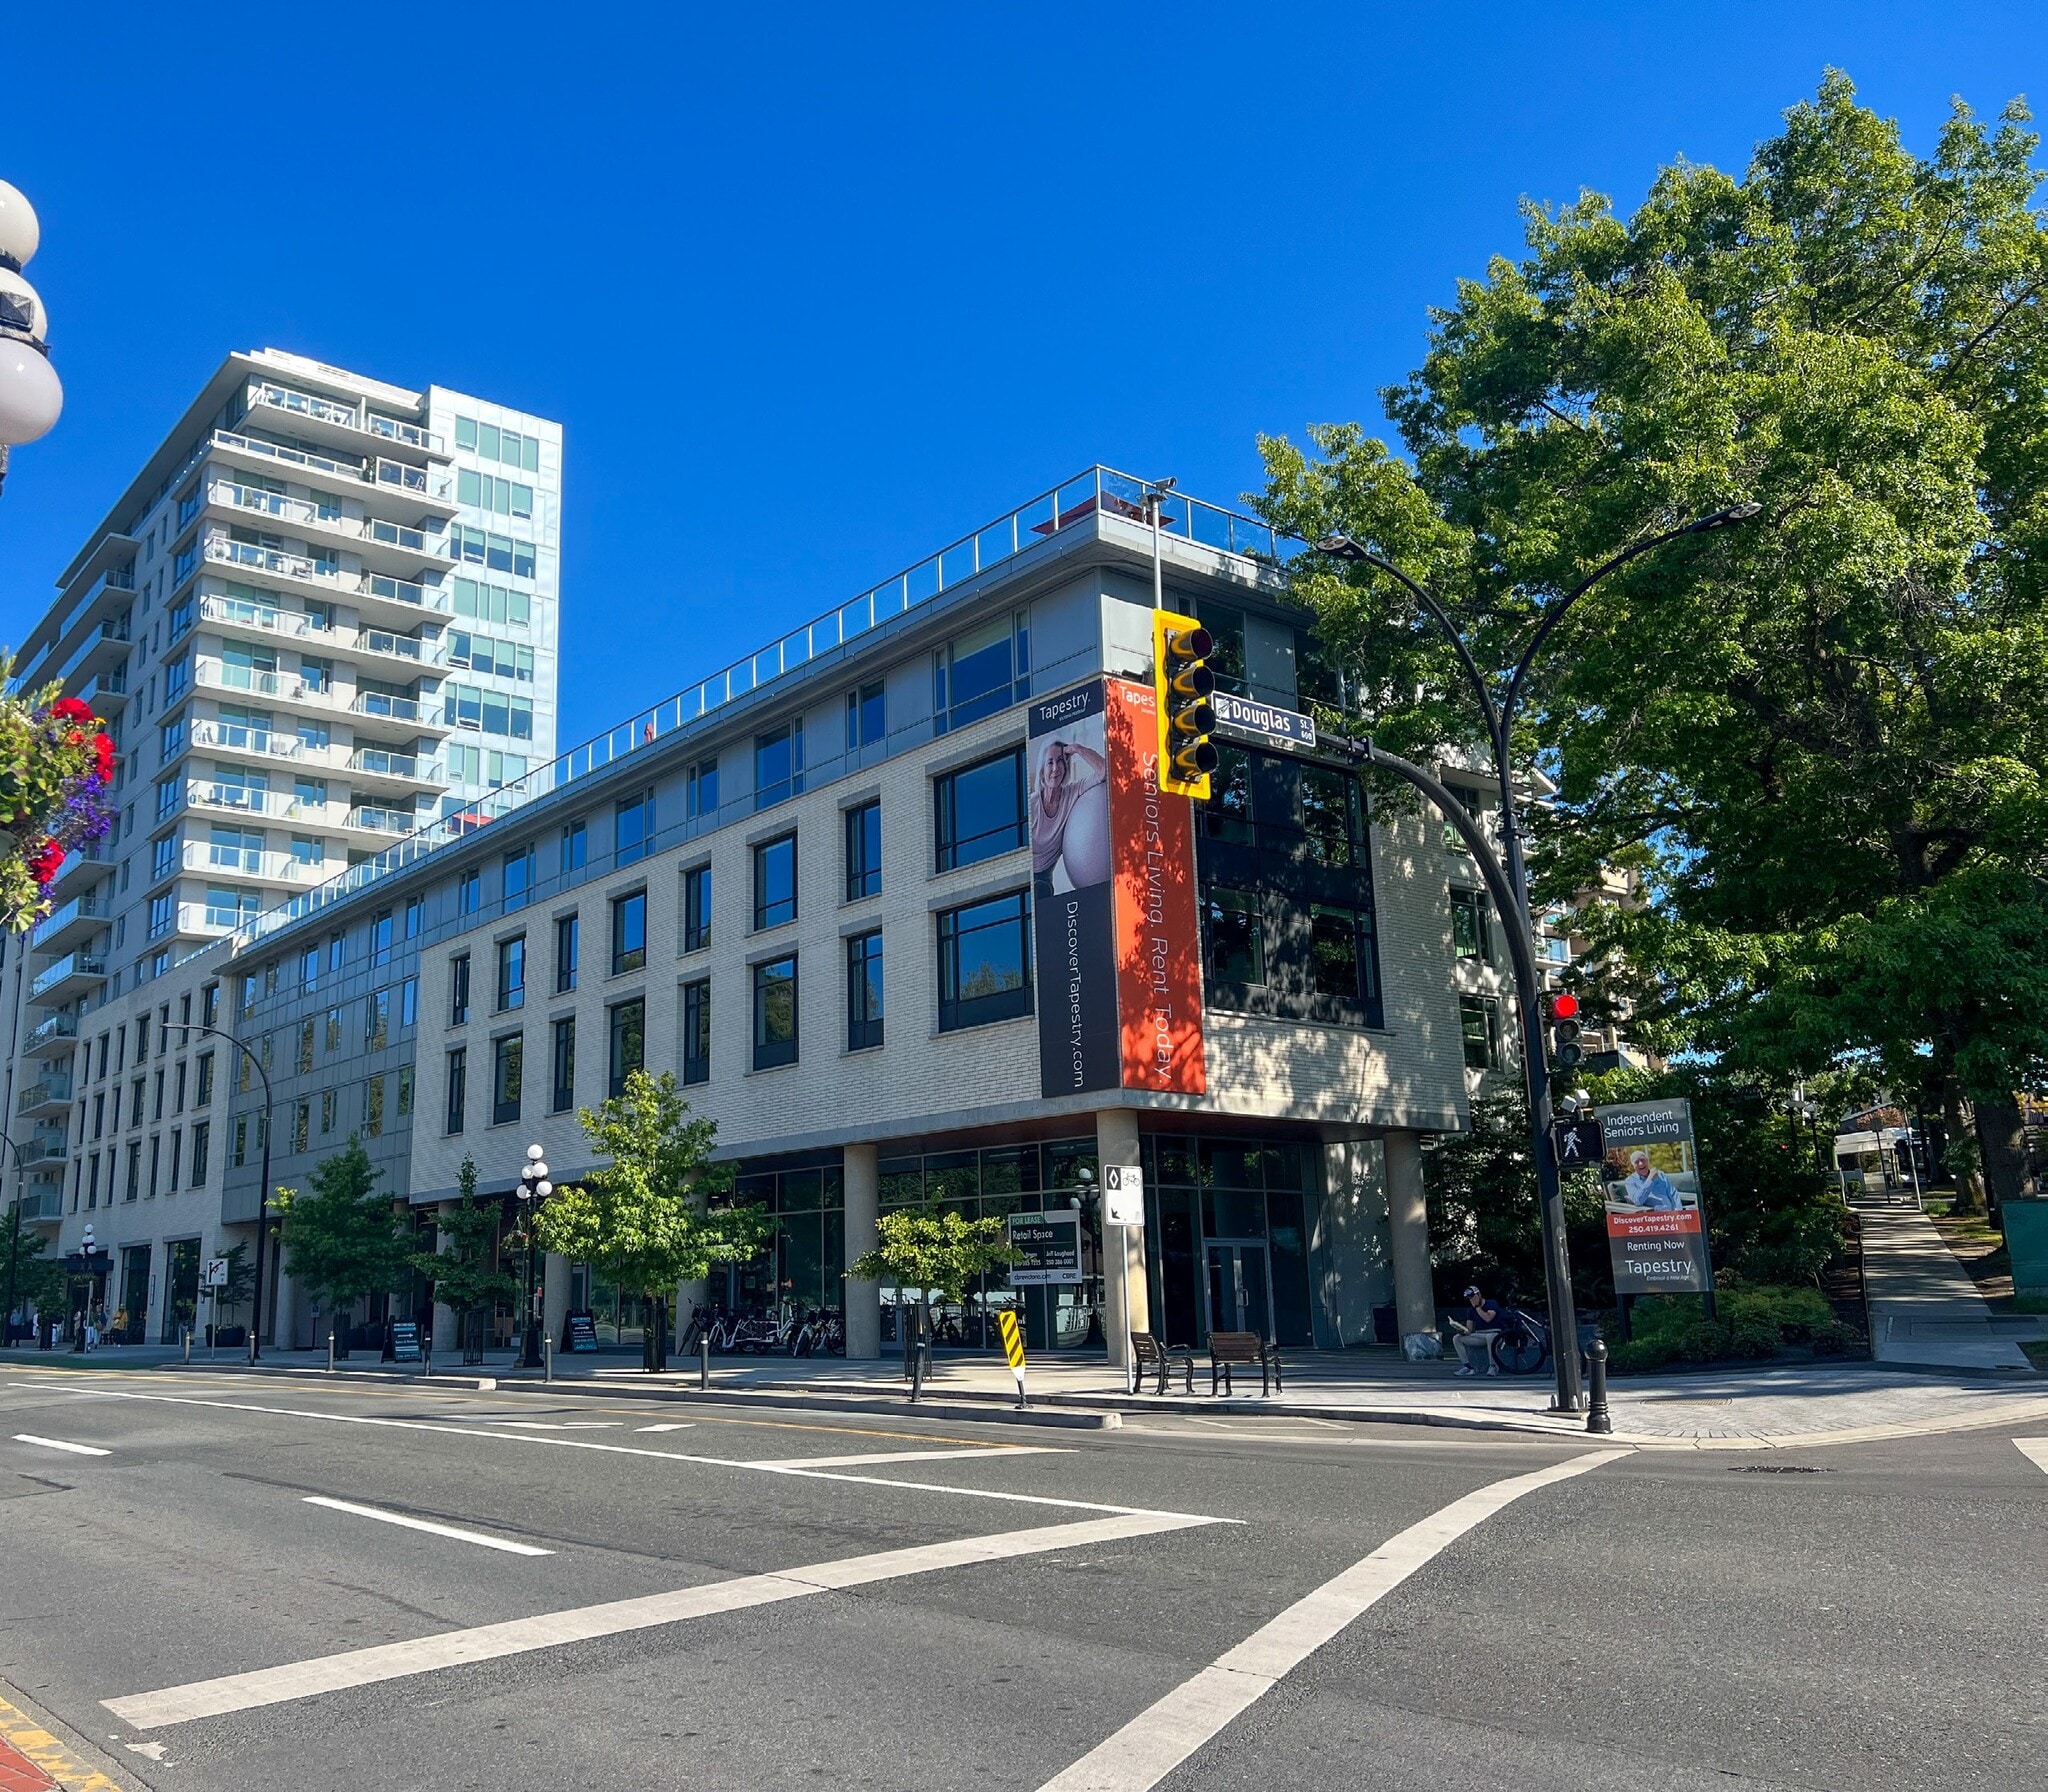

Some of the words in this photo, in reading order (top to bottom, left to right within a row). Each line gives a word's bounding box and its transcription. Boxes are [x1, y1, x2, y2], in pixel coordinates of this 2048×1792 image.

[1119, 686, 1156, 707] Tapes
[1232, 701, 1291, 732] Douglas
[1143, 751, 1160, 843] Seniors
[1151, 937, 1169, 995] Rent
[1066, 901, 1084, 1088] DiscoverTapestry.com
[1154, 1003, 1175, 1084] Today.
[1607, 1109, 1673, 1126] Independent
[1604, 1126, 1645, 1138] Seniors
[1646, 1122, 1679, 1134] Living
[1012, 1217, 1024, 1225] FOR
[1024, 1216, 1041, 1224] LEASE
[1613, 1213, 1692, 1225] DiscoverTapestry.com
[1012, 1229, 1031, 1240] Retail
[1628, 1224, 1679, 1234] 250.419.4261
[1627, 1241, 1662, 1252] Renting
[1663, 1240, 1685, 1250] Now
